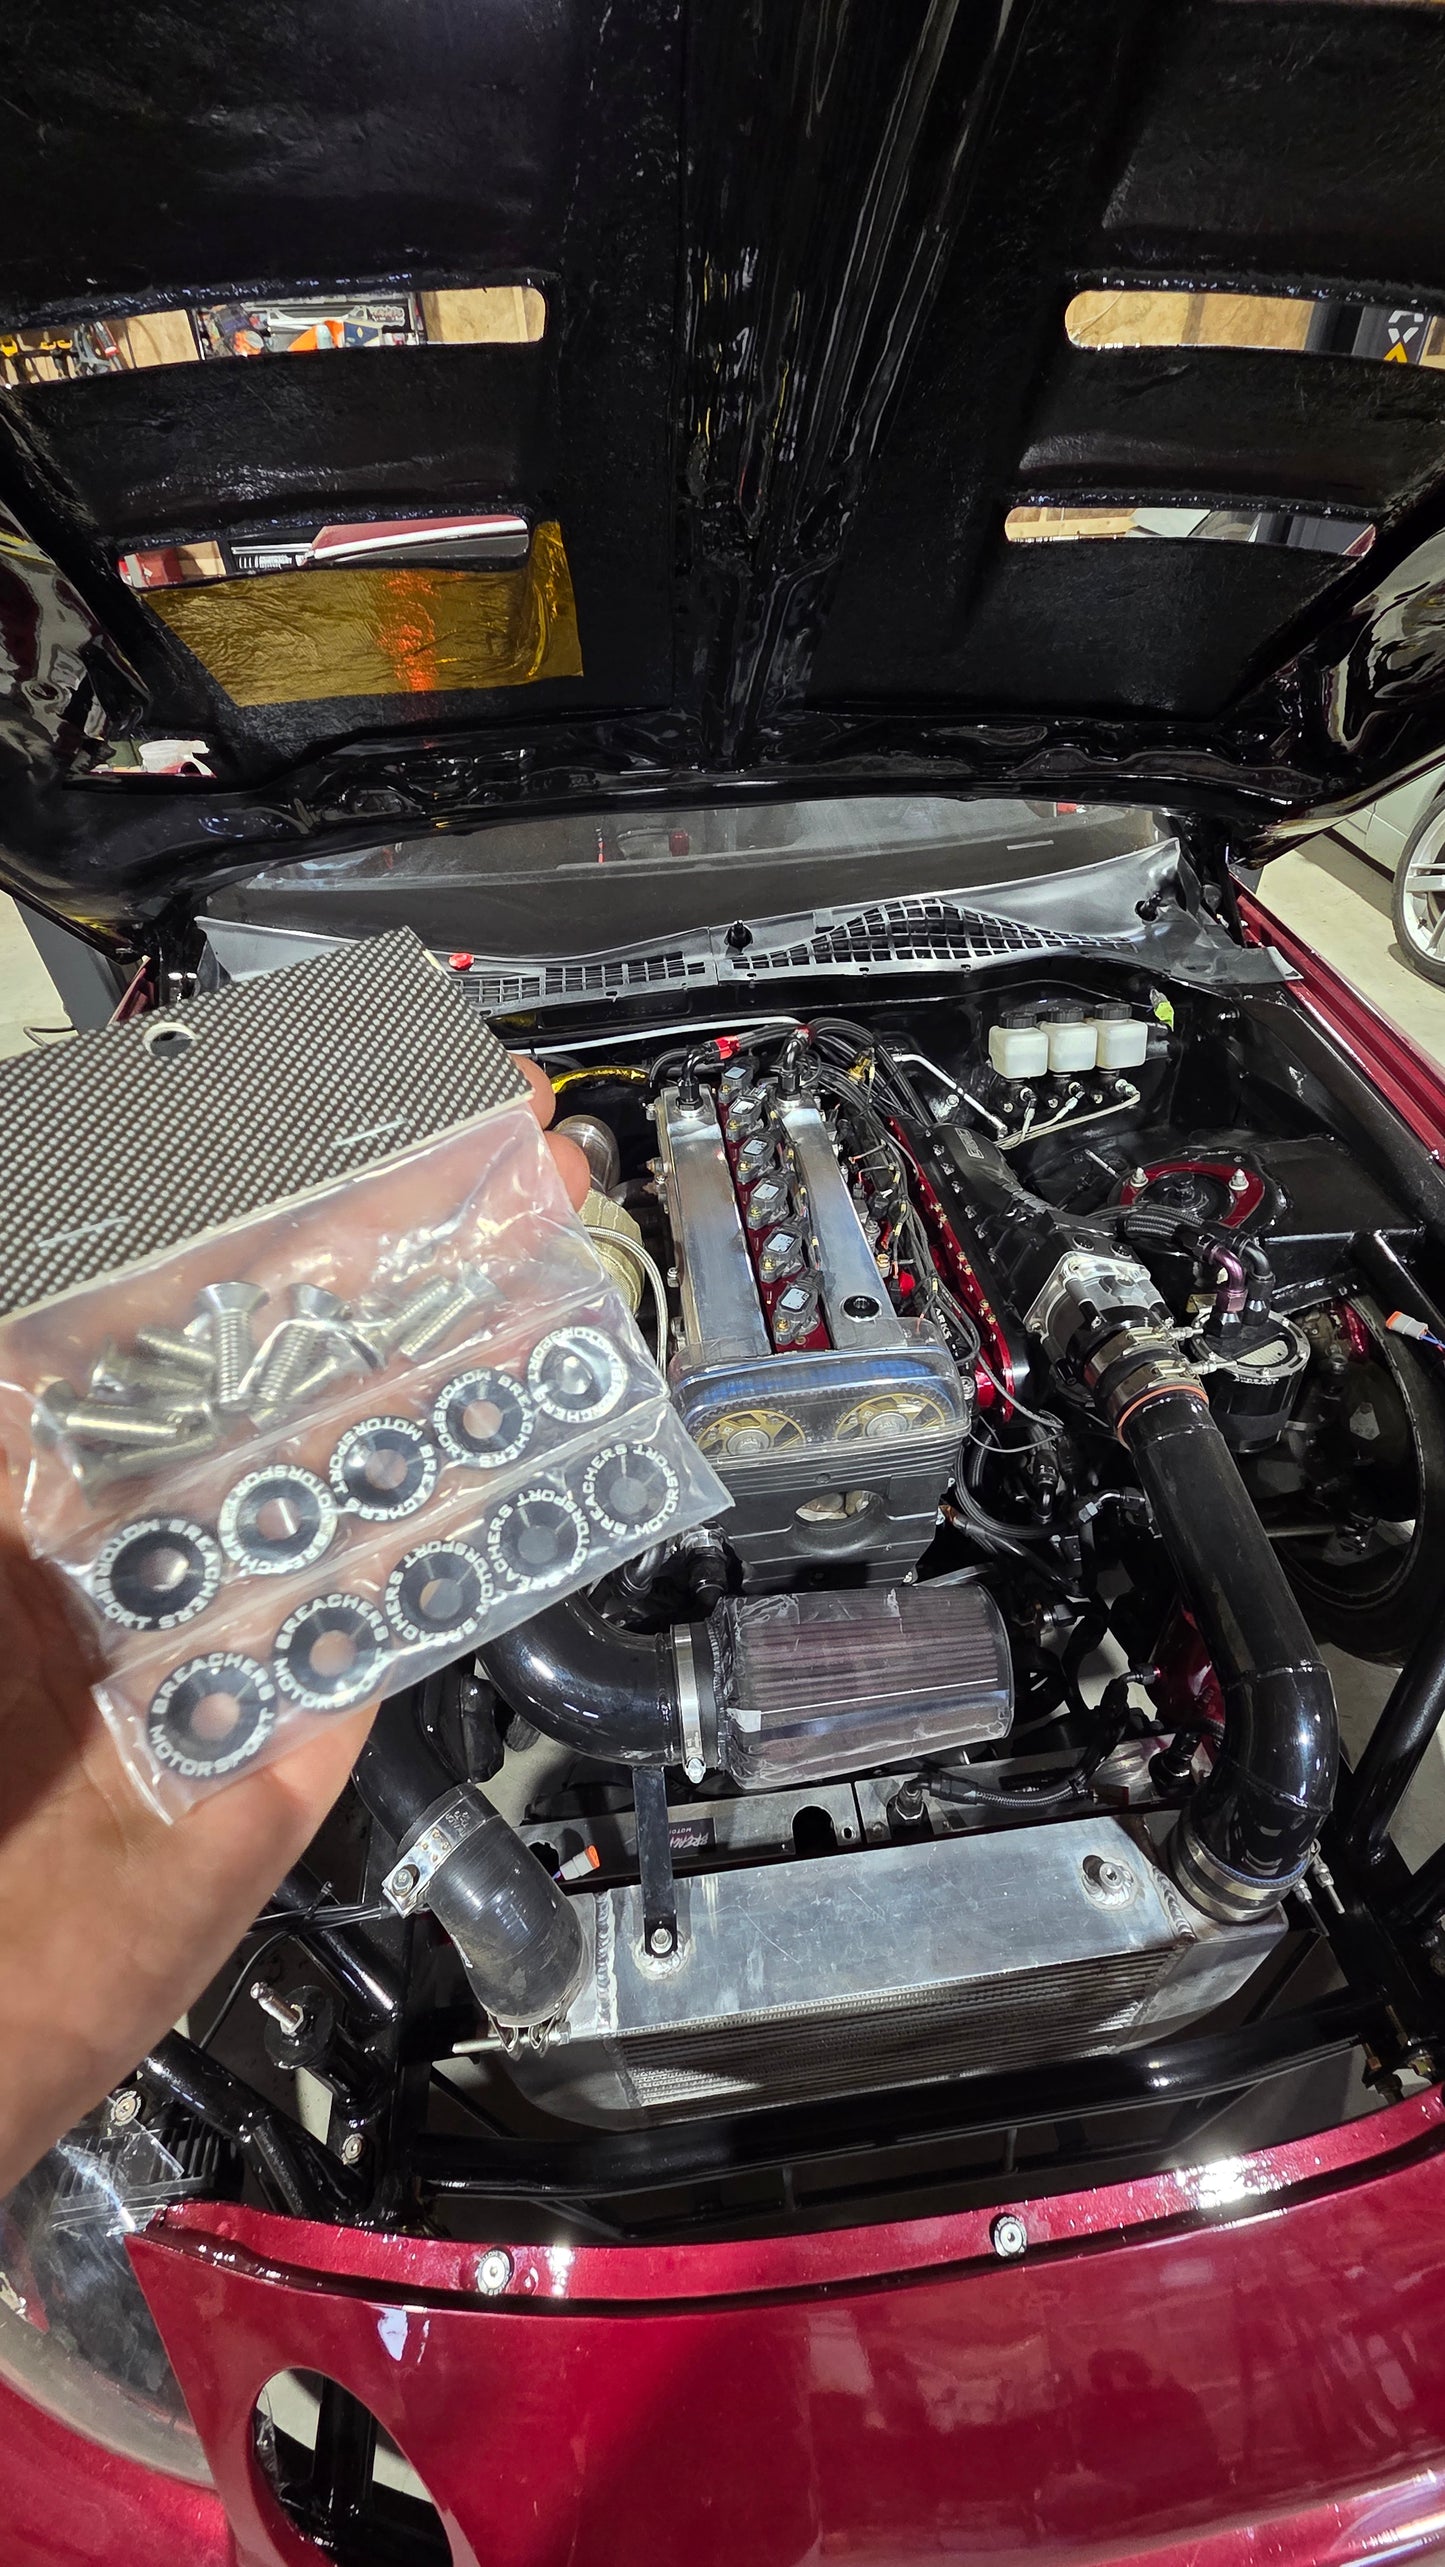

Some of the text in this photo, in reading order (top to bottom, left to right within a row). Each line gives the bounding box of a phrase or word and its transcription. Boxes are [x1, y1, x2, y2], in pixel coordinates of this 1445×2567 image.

[329, 1417, 424, 1495] MOTORSPORT
[433, 1369, 492, 1464] MOTORSPORT
[480, 1374, 534, 1469] BREACHERS
[345, 1443, 438, 1521] BREACHERS
[582, 1443, 628, 1536] BREACHERS
[633, 1444, 680, 1537] MOTORSPORT
[92, 1518, 161, 1630] MOTORSPORT
[158, 1519, 220, 1630] BREACHERS
[517, 1488, 590, 1576] MOTORSPORT
[275, 1593, 389, 1650] BREACHERS
[403, 1540, 495, 1616] MOTORSPORT
[152, 1652, 276, 1715] BREACHERS
[149, 1706, 276, 1777] MOTORSPORT
